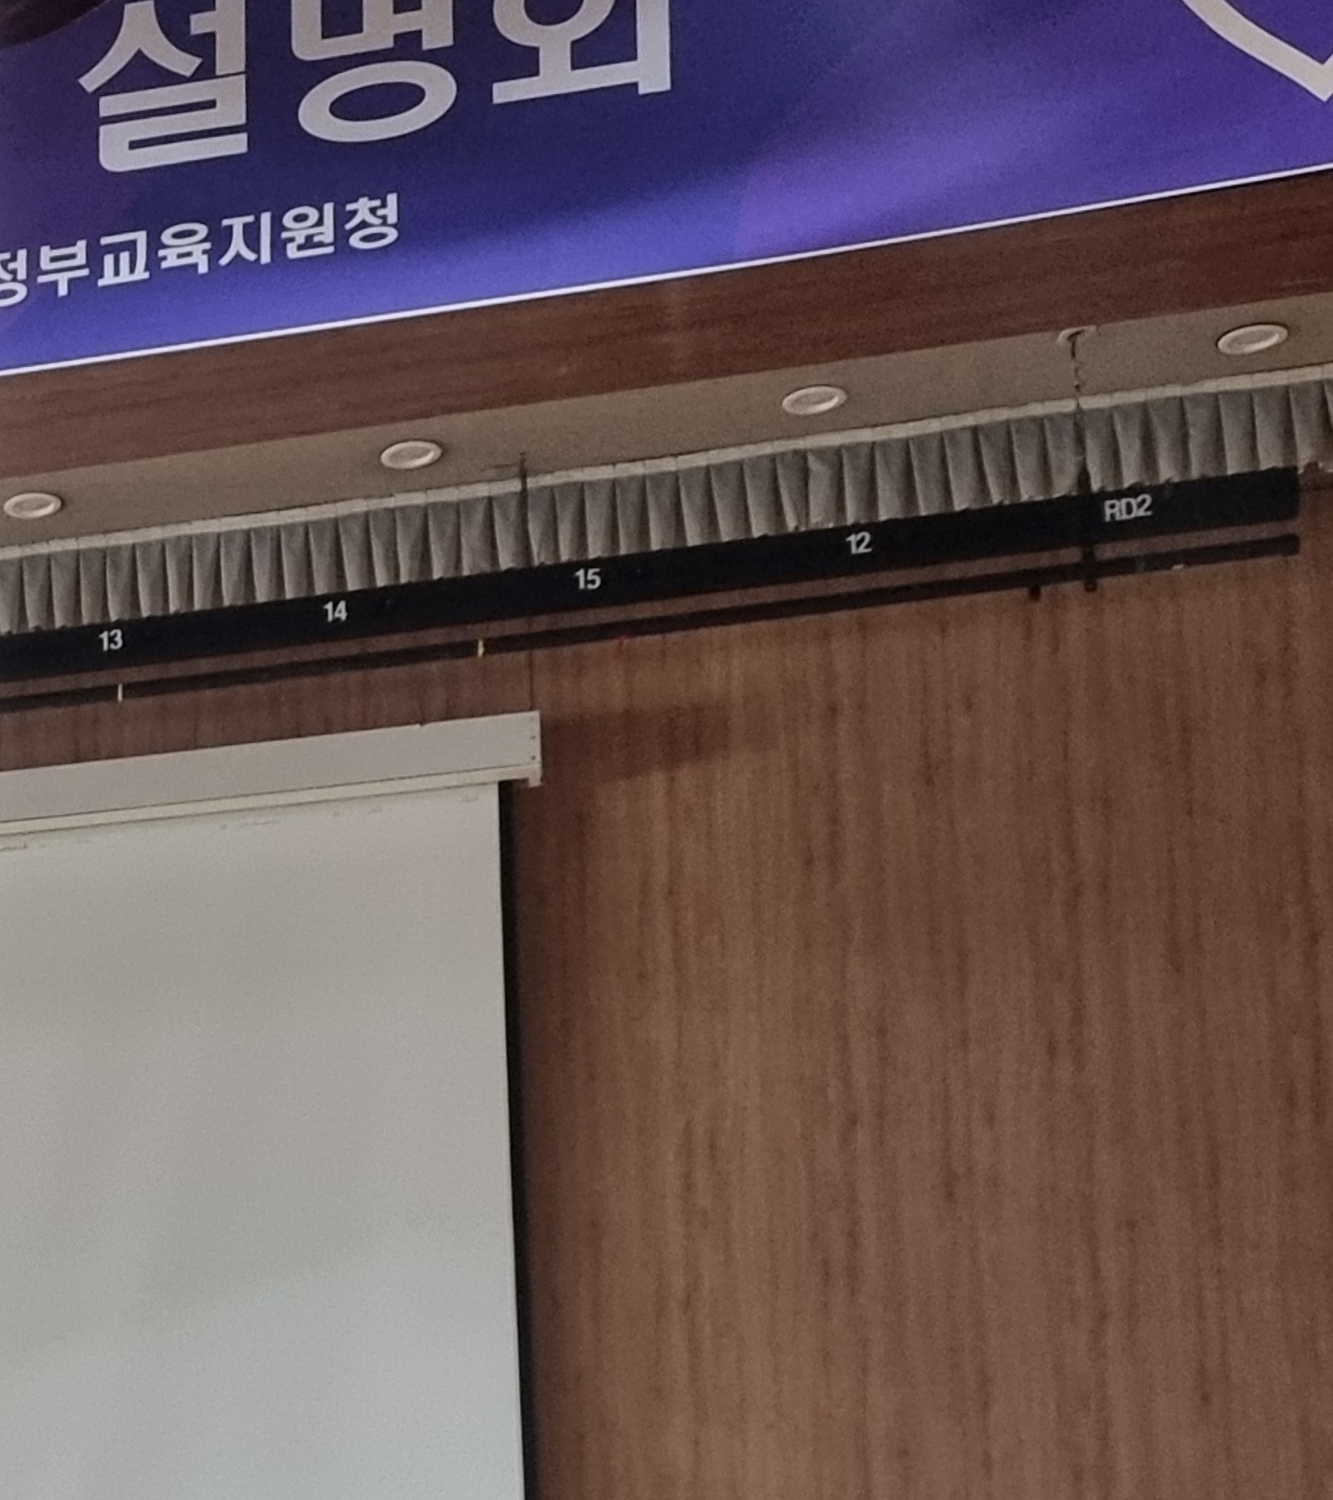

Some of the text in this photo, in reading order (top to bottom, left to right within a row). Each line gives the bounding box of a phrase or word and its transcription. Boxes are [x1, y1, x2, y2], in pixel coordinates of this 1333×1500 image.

[1103, 493, 1153, 522] RD2
[845, 531, 873, 555] 12
[574, 567, 602, 590] 15
[323, 600, 348, 623] 14
[99, 628, 123, 652] 13
